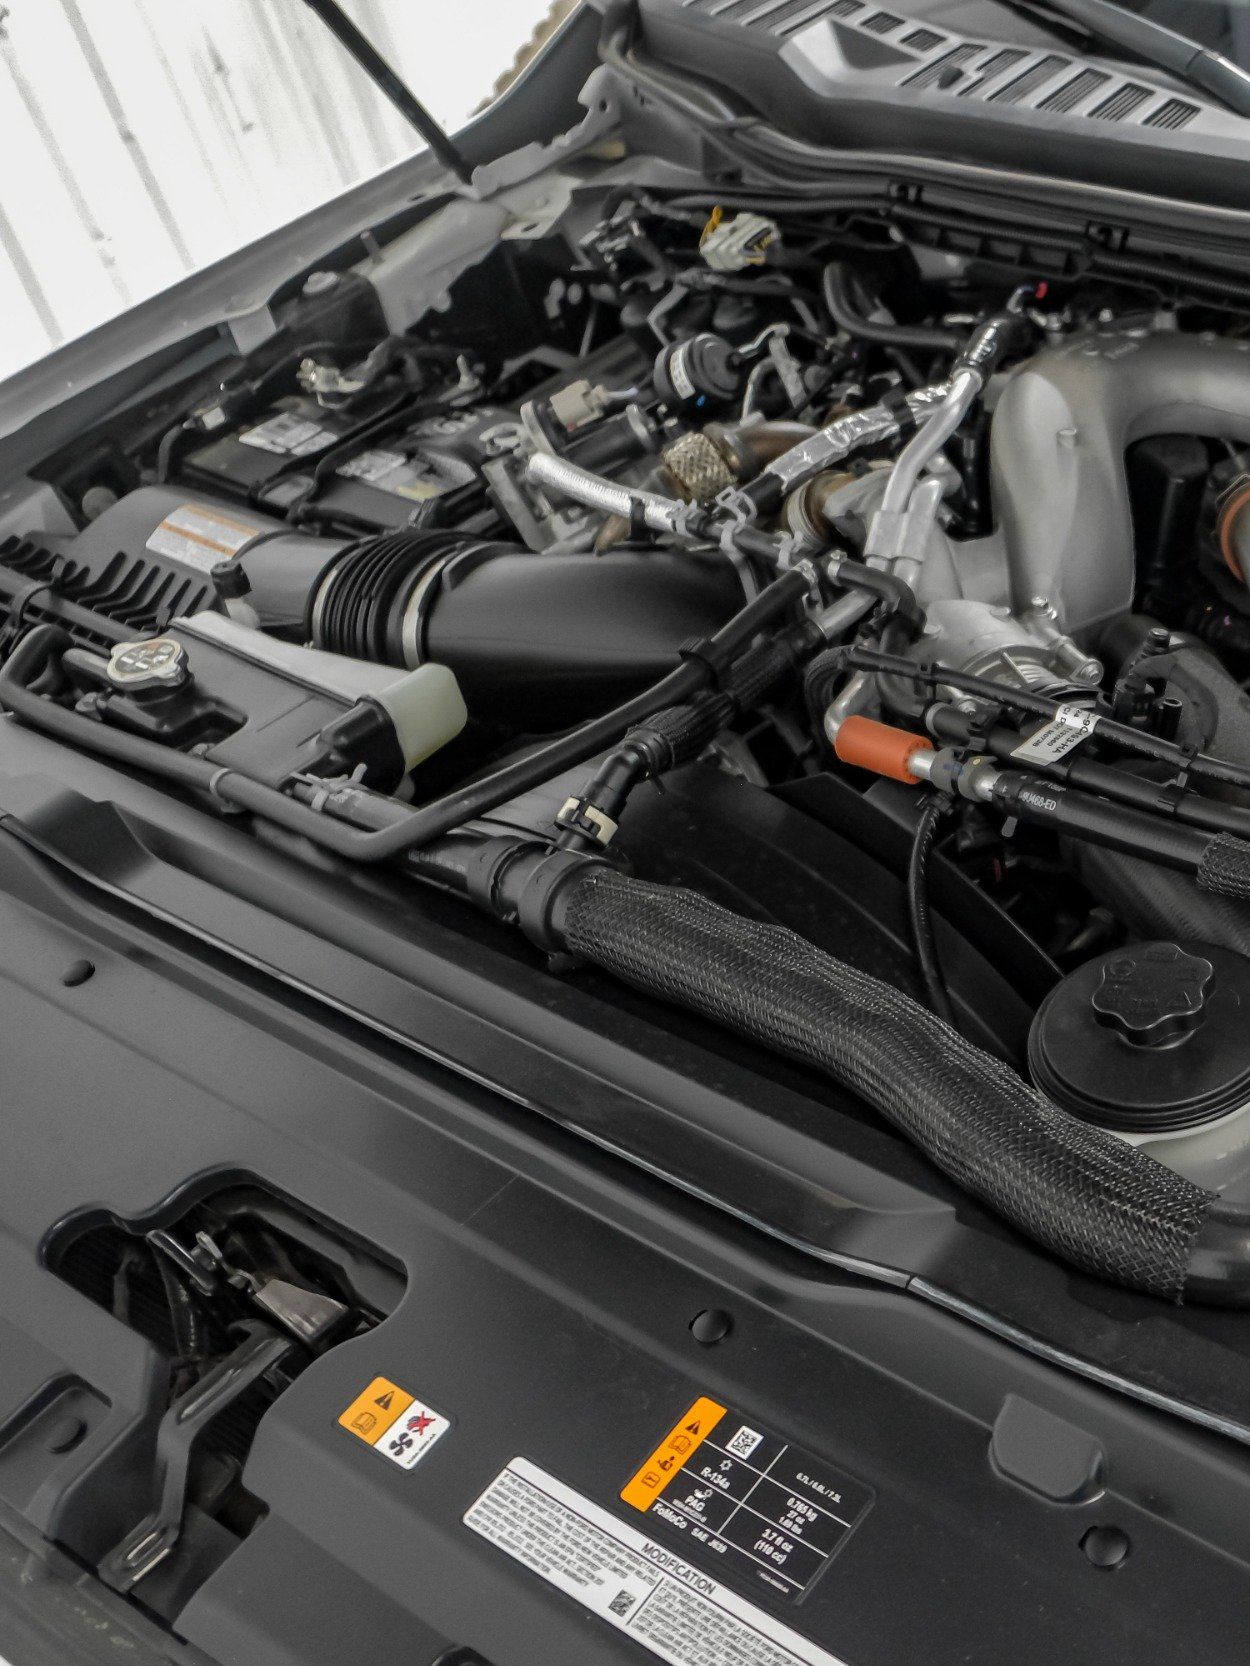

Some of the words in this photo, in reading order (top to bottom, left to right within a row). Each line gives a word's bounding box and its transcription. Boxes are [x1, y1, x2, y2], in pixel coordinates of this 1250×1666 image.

[700, 1466, 730, 1489] R-134a
[685, 1495, 706, 1512] PAG
[653, 1503, 688, 1529] FoMoCo
[761, 1528, 776, 1542] 3.7
[641, 1542, 717, 1596] MODIFICATION
